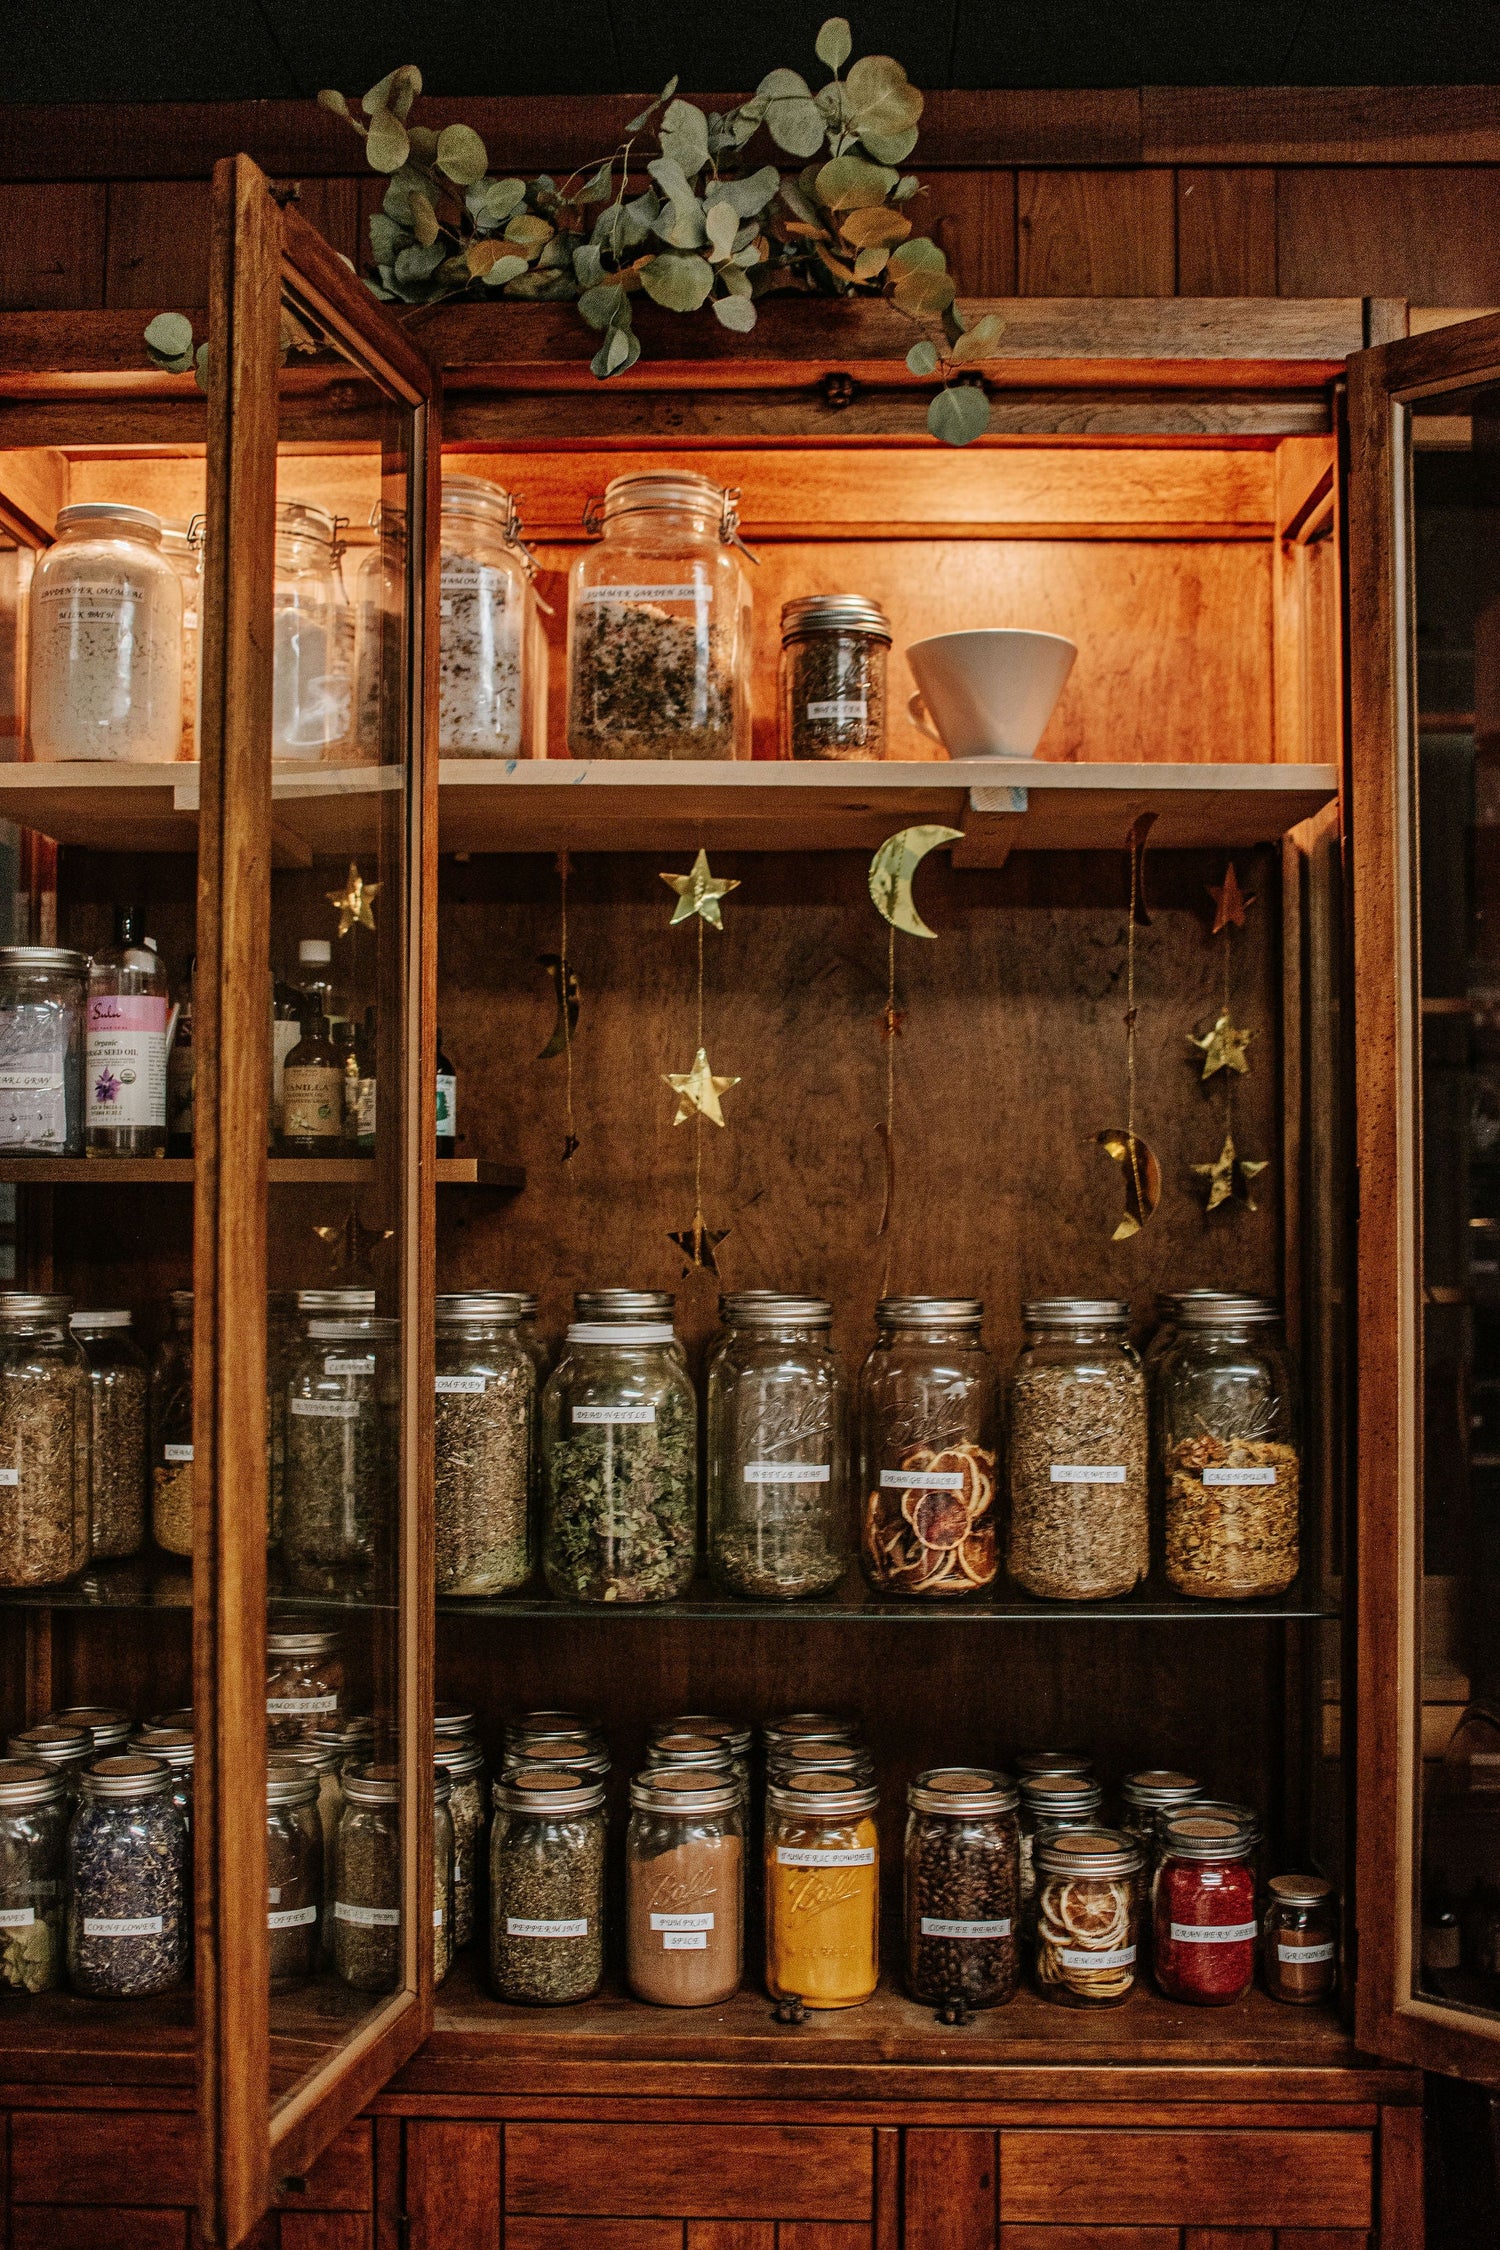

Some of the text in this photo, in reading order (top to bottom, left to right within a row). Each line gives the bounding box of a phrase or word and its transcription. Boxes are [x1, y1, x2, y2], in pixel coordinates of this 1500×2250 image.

[586, 588, 697, 599] SUMMER GARDEN SOA
[58, 610, 115, 620] MILK BATH
[0, 1075, 52, 1086] ARL GRAY
[286, 1083, 330, 1092] ANILLA
[437, 1380, 484, 1390] OMFREY
[577, 1411, 647, 1419] DEAD NETTLE
[752, 1470, 822, 1479] NETTLE LEAF
[1208, 1473, 1267, 1481] CALENDULA
[884, 1475, 921, 1485] ORANGE
[87, 1922, 157, 1932] CORNFLOWER
[512, 1923, 582, 1933] PEPPERMINT
[660, 1919, 708, 1927] PUMPKIN
[671, 1937, 699, 1945] SPICE
